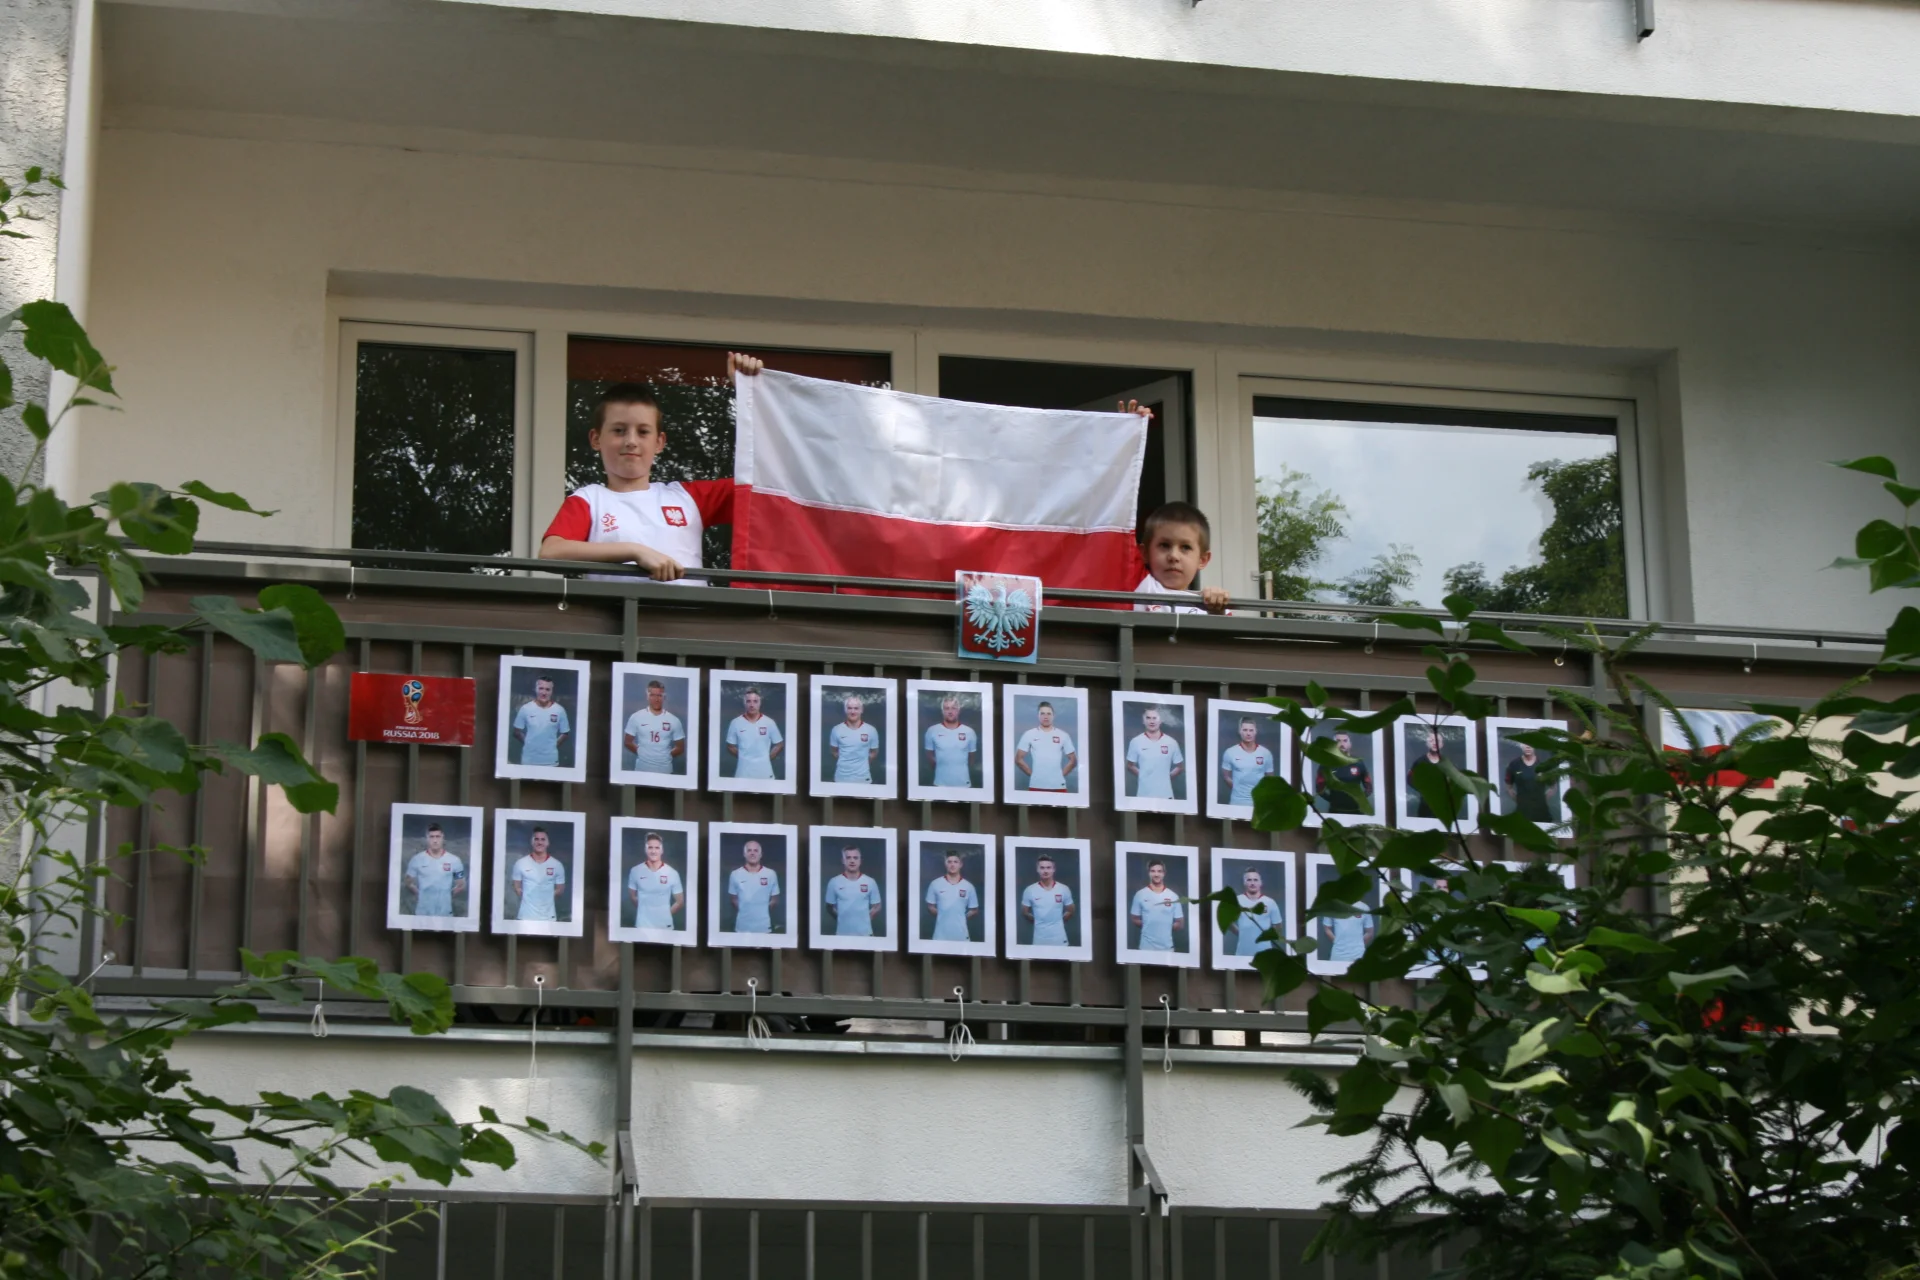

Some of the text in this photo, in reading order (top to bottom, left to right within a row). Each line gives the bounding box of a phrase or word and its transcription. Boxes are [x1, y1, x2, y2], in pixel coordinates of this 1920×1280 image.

[383, 729, 440, 740] RUSSIA 2018
[650, 730, 661, 743] 16
